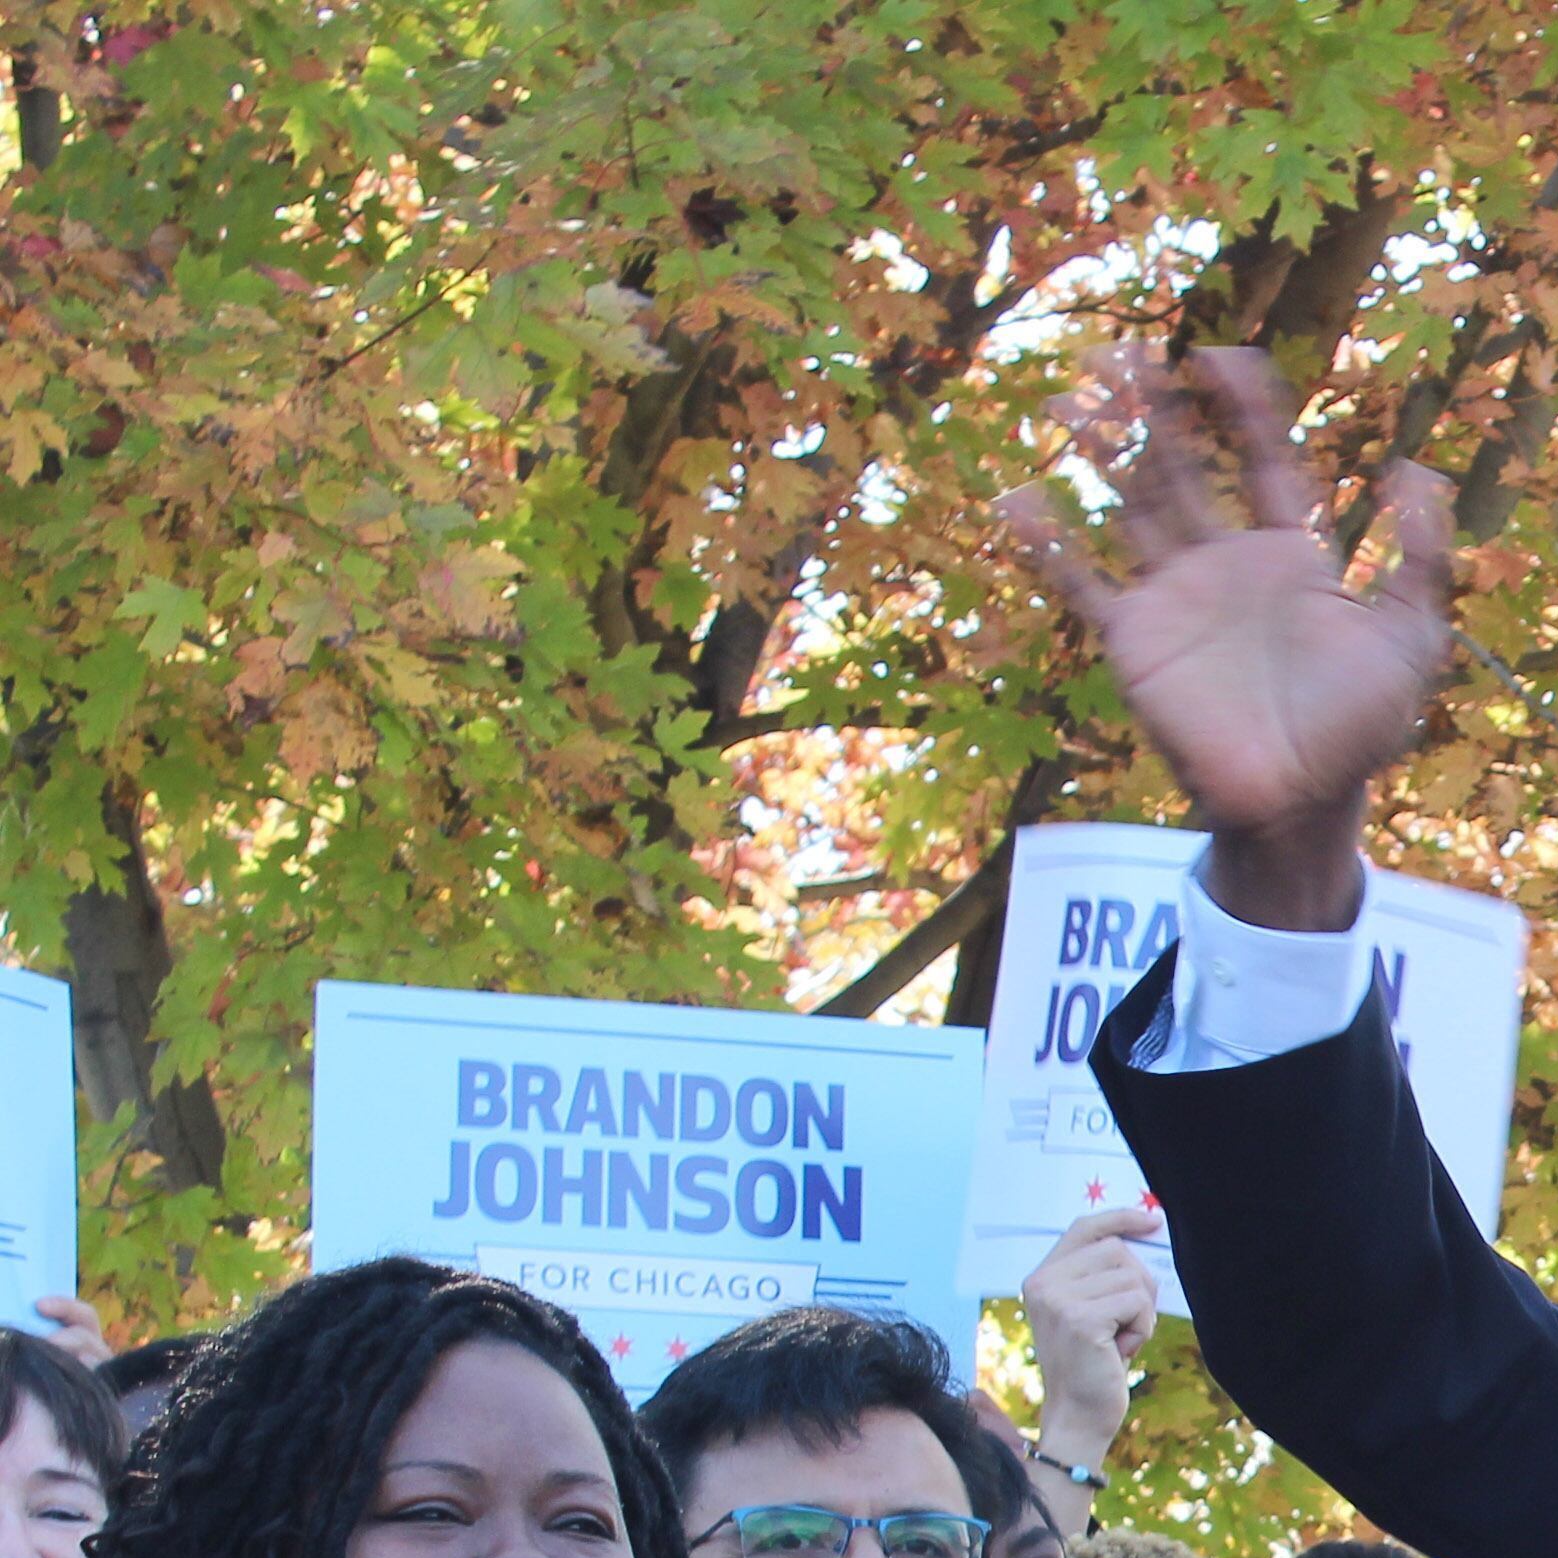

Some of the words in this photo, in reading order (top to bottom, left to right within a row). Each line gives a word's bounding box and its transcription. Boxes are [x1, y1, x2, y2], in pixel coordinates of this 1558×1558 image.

[457, 1058, 846, 1151] BRANDON
[432, 1139, 863, 1243] JOHNSON
[518, 1261, 591, 1293] FOR
[607, 1266, 782, 1302] CHICAGO
